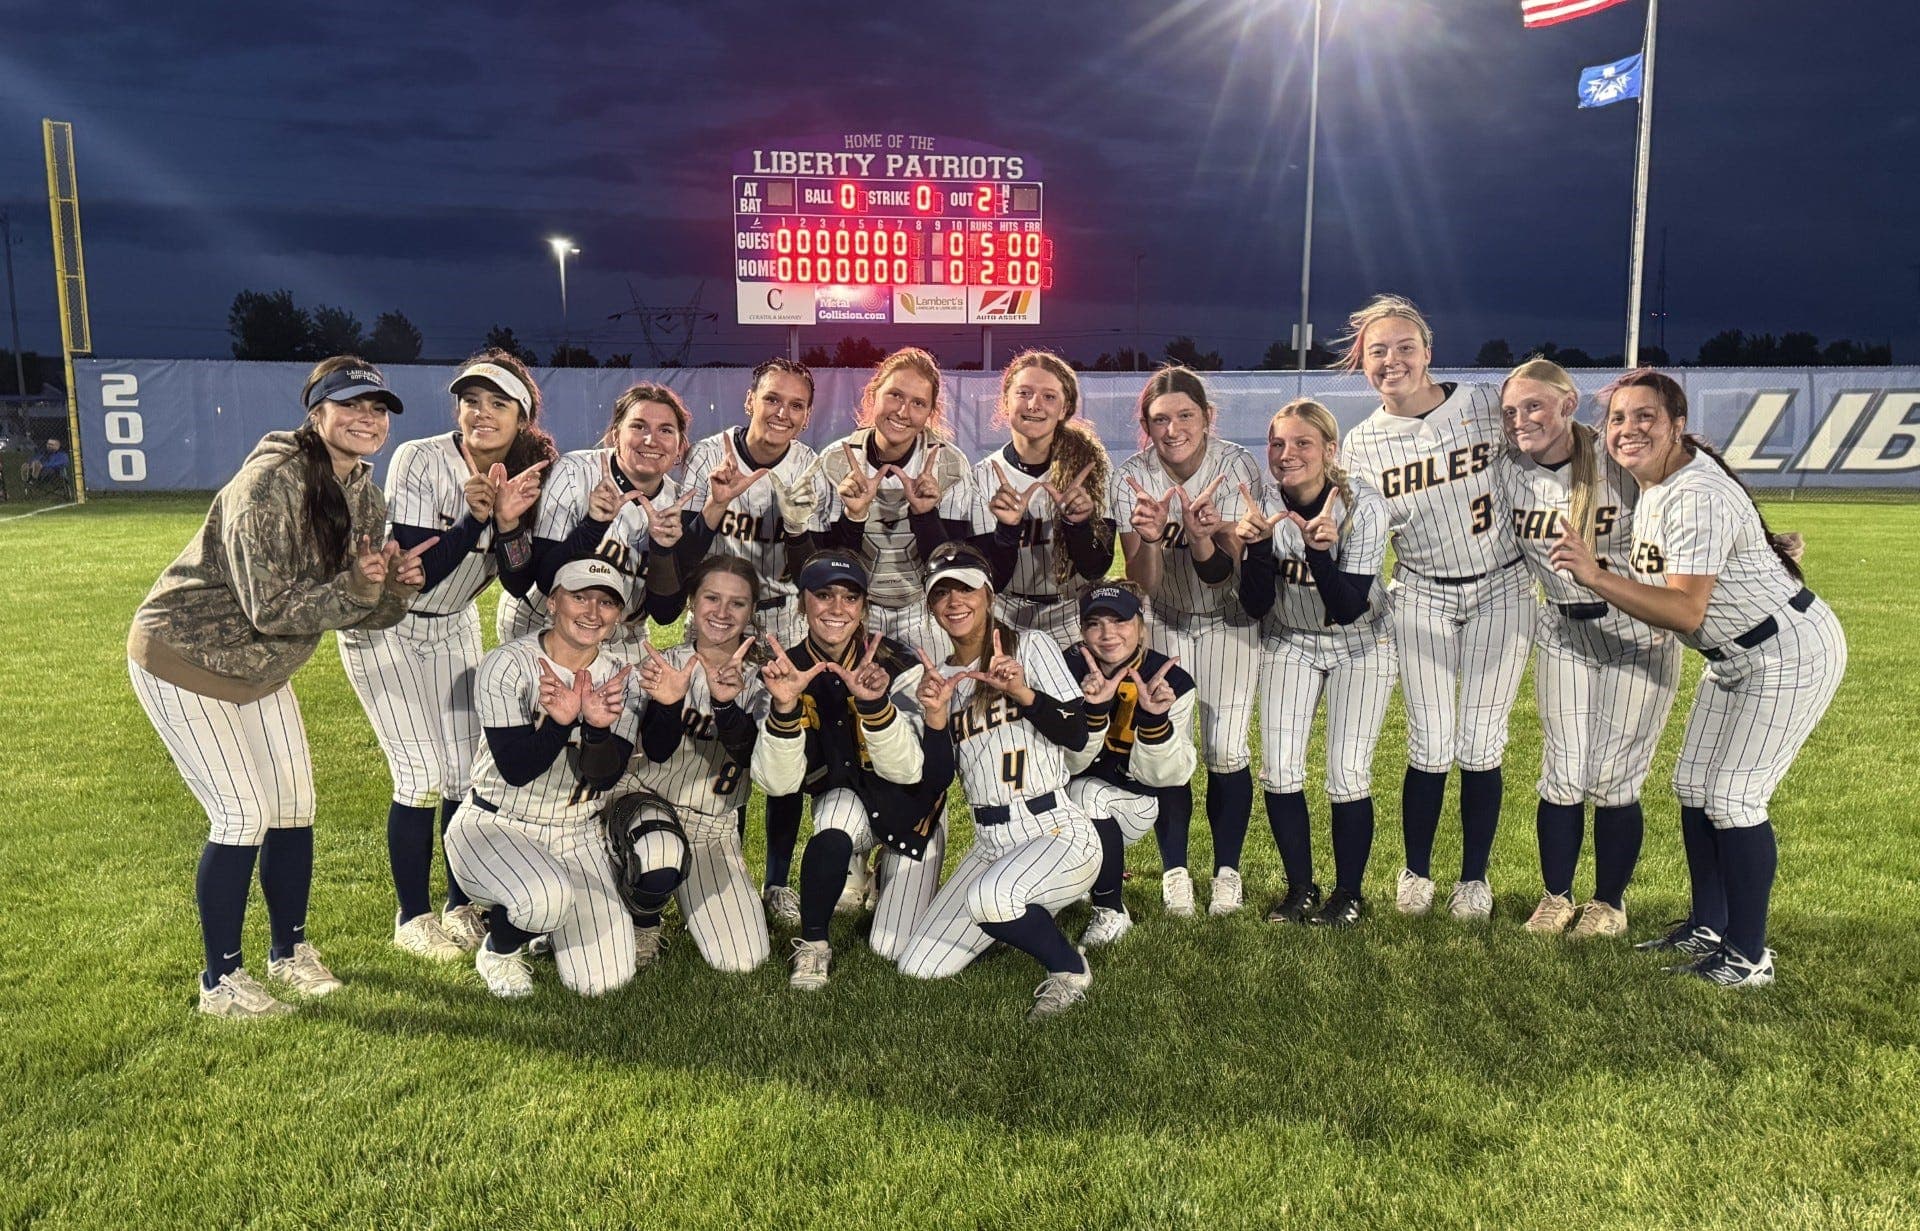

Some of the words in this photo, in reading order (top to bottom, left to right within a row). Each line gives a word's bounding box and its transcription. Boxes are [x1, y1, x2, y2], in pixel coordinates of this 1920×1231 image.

[844, 134, 883, 149] HOME
[888, 134, 903, 149] OF
[909, 135, 935, 152] THE
[753, 150, 876, 177] LIBERTY
[886, 153, 1024, 180] PATRIOTS
[744, 183, 758, 197] AT
[805, 188, 834, 204] BALL
[840, 183, 855, 209] 0
[868, 190, 911, 206] STRIKE
[916, 185, 931, 211] 0
[950, 192, 974, 207] OUT
[977, 187, 992, 212] 2
[740, 198, 762, 212] BAT
[781, 217, 786, 227] 1
[800, 218, 806, 228] 2
[820, 218, 826, 228] 3
[839, 219, 846, 229] 4
[858, 219, 864, 229] 5
[878, 220, 884, 230] 6
[897, 220, 903, 230] 7
[916, 221, 922, 231] 8
[935, 221, 941, 231] 9
[951, 221, 962, 231] 10
[970, 221, 993, 231] RUNS
[1000, 222, 1018, 231] HITS
[1024, 222, 1041, 232] ERR
[737, 232, 776, 250] GUEST
[777, 228, 791, 254] 0
[796, 229, 811, 254] 0
[816, 230, 830, 254] 0
[836, 230, 850, 255] 0
[855, 231, 869, 255] 0
[873, 231, 888, 255] 0
[893, 231, 907, 256] 0
[950, 231, 963, 257] 0
[980, 232, 994, 257] 5
[738, 259, 776, 277] HOME
[777, 257, 792, 282] 0
[797, 257, 811, 282] 0
[817, 258, 831, 282] 0
[836, 258, 850, 282] 0
[855, 258, 869, 283] 0
[874, 259, 888, 283] 0
[893, 259, 907, 284] 0
[950, 260, 963, 284] 0
[980, 260, 994, 285] 2
[766, 288, 783, 311] C
[916, 296, 963, 306] Lambert's
[819, 310, 885, 320] Collision.com
[101, 373, 147, 481] 200
[1382, 443, 1490, 499] GALES
[1471, 493, 1493, 536] 3
[1512, 506, 1617, 539] GALS
[713, 761, 742, 796] 8
[1002, 749, 1027, 792] 4
